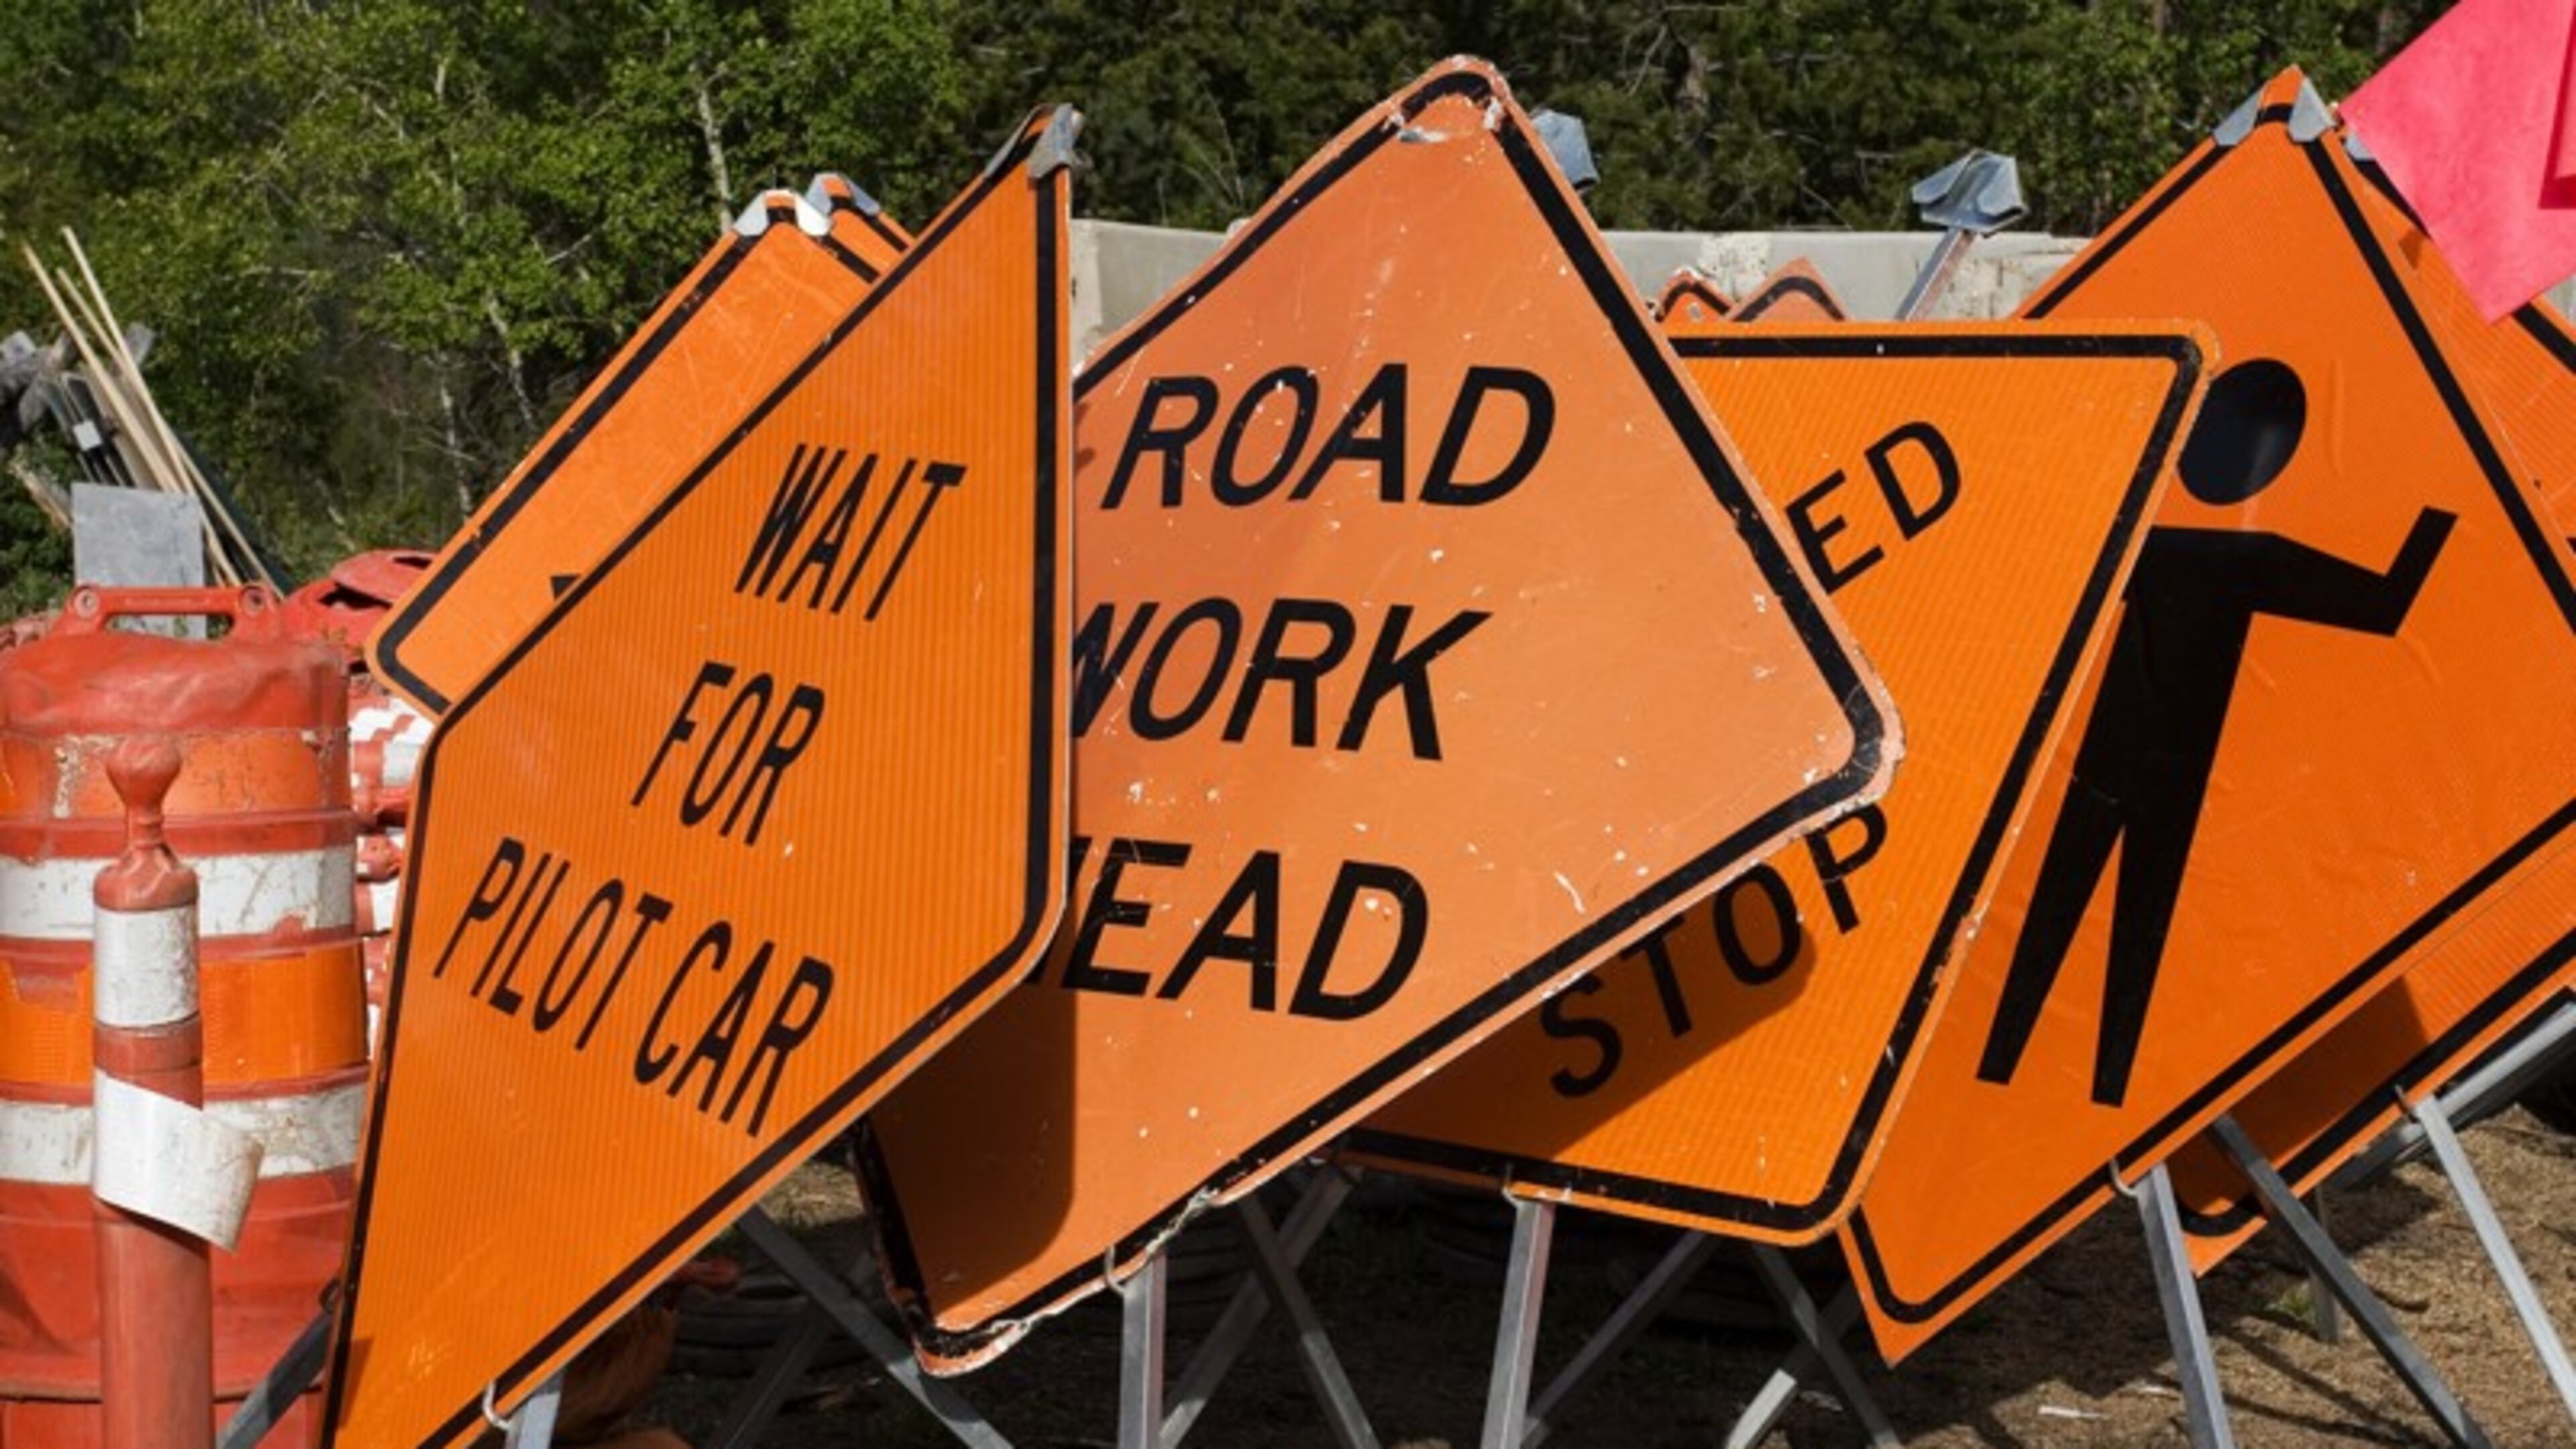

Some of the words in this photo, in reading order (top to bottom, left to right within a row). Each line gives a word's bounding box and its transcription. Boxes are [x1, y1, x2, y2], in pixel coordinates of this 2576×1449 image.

[1101, 363, 1556, 510] ROAD
[734, 443, 966, 621] WAIT
[631, 661, 825, 845] FOR
[433, 837, 672, 1051] PILOT
[633, 921, 835, 1136] CAR
[1539, 804, 1888, 1098] STOP
